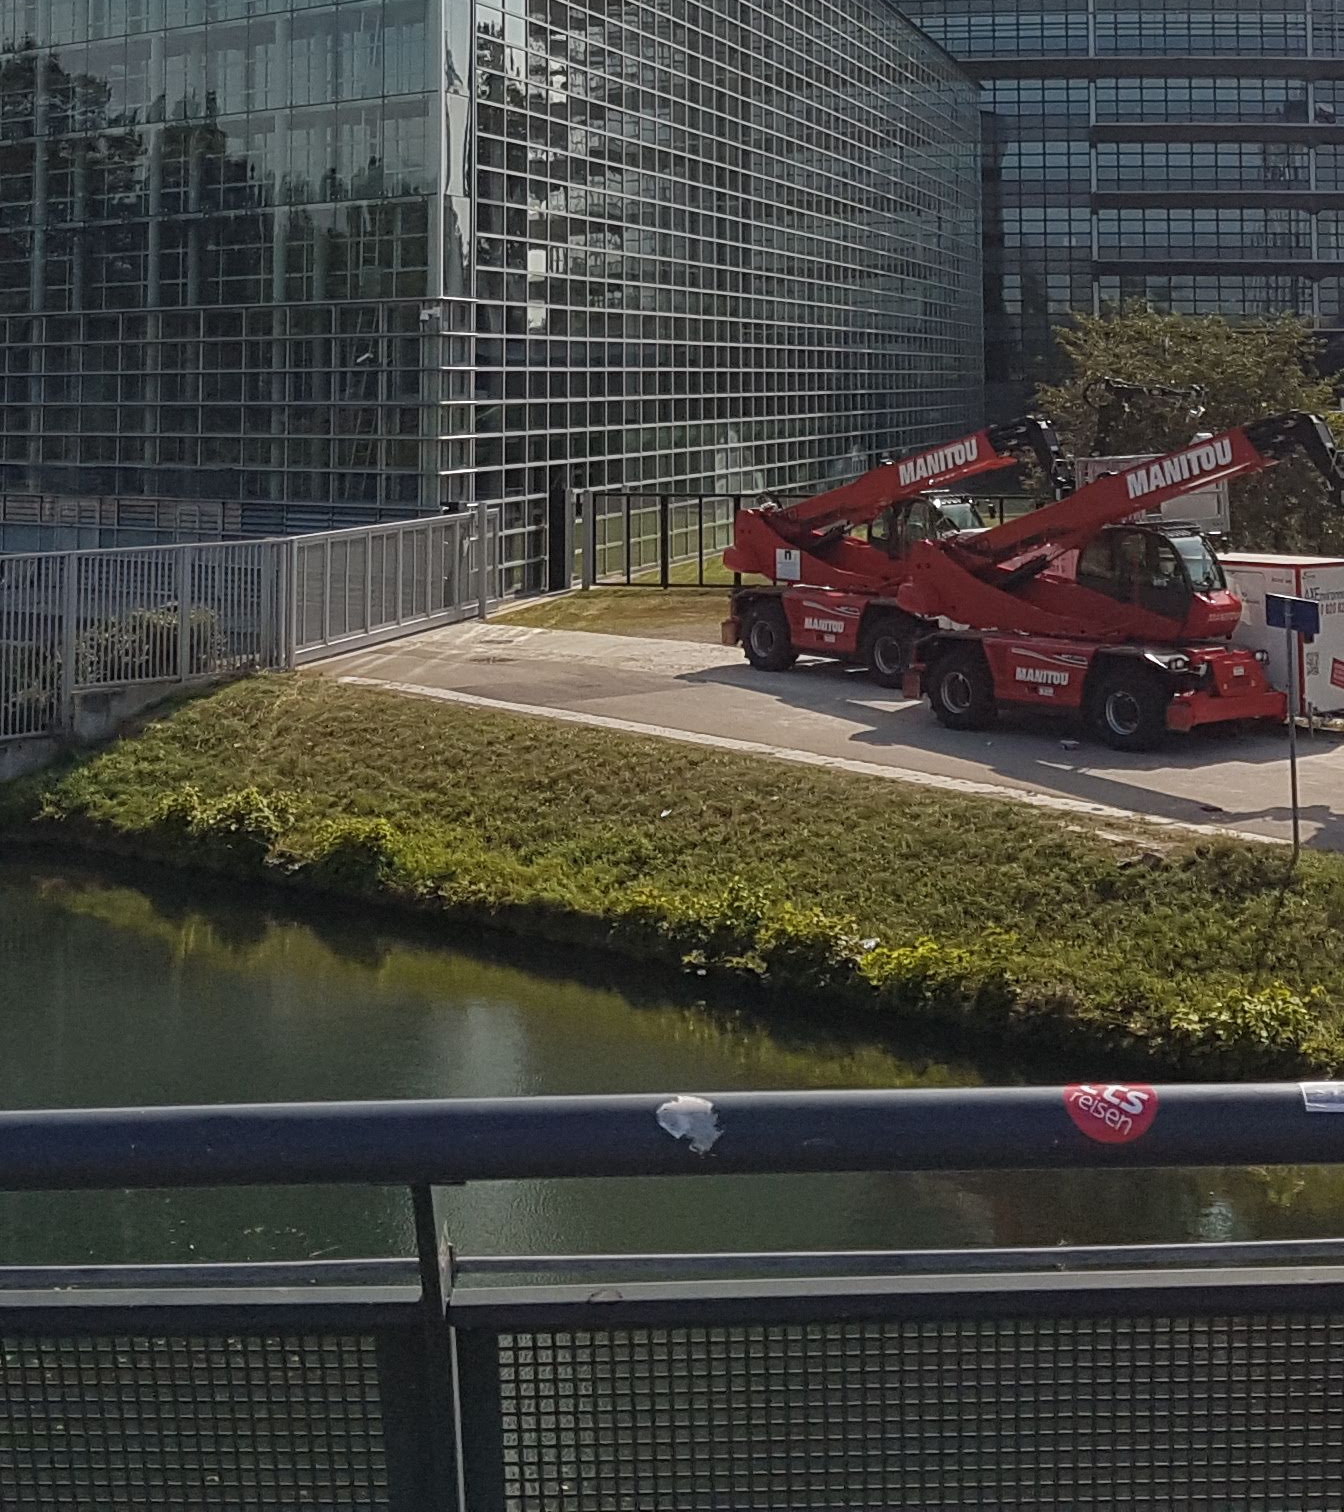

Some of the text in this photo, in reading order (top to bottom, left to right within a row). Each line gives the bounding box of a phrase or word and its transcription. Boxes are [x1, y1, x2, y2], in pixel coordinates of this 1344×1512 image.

[898, 438, 978, 487] MANITOU
[1126, 438, 1233, 500] MANITOU
[804, 616, 845, 634] MANITOU
[1015, 666, 1070, 686] MANITOU
[1068, 1091, 1133, 1136] reisen
